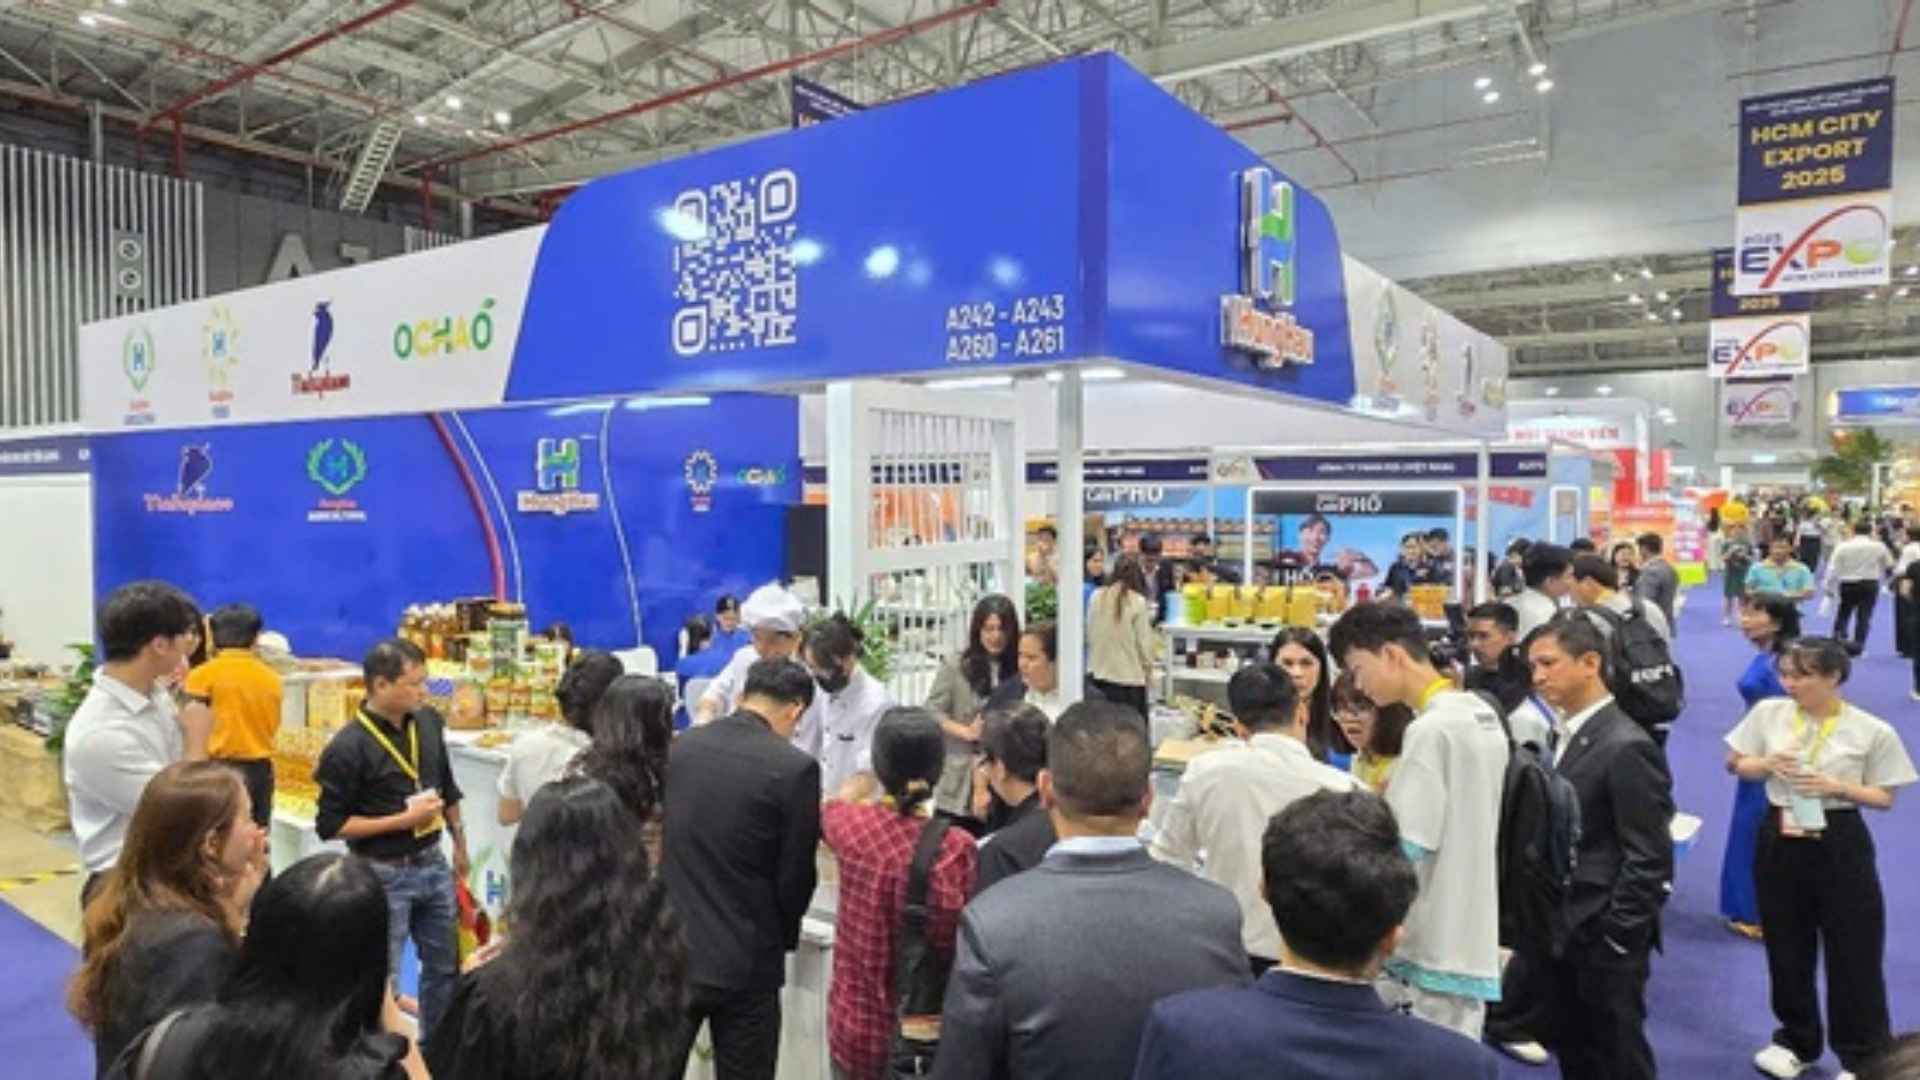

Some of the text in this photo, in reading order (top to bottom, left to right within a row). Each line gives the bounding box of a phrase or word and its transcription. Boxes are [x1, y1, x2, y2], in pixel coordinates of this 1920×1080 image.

[1751, 110, 1883, 144] HCM CITY
[1764, 137, 1868, 167] EXPORT
[1780, 164, 1846, 190] 2025
[946, 302, 995, 331] A242
[1011, 294, 1064, 324] A243
[946, 332, 998, 361] A260
[1015, 325, 1064, 356] A261
